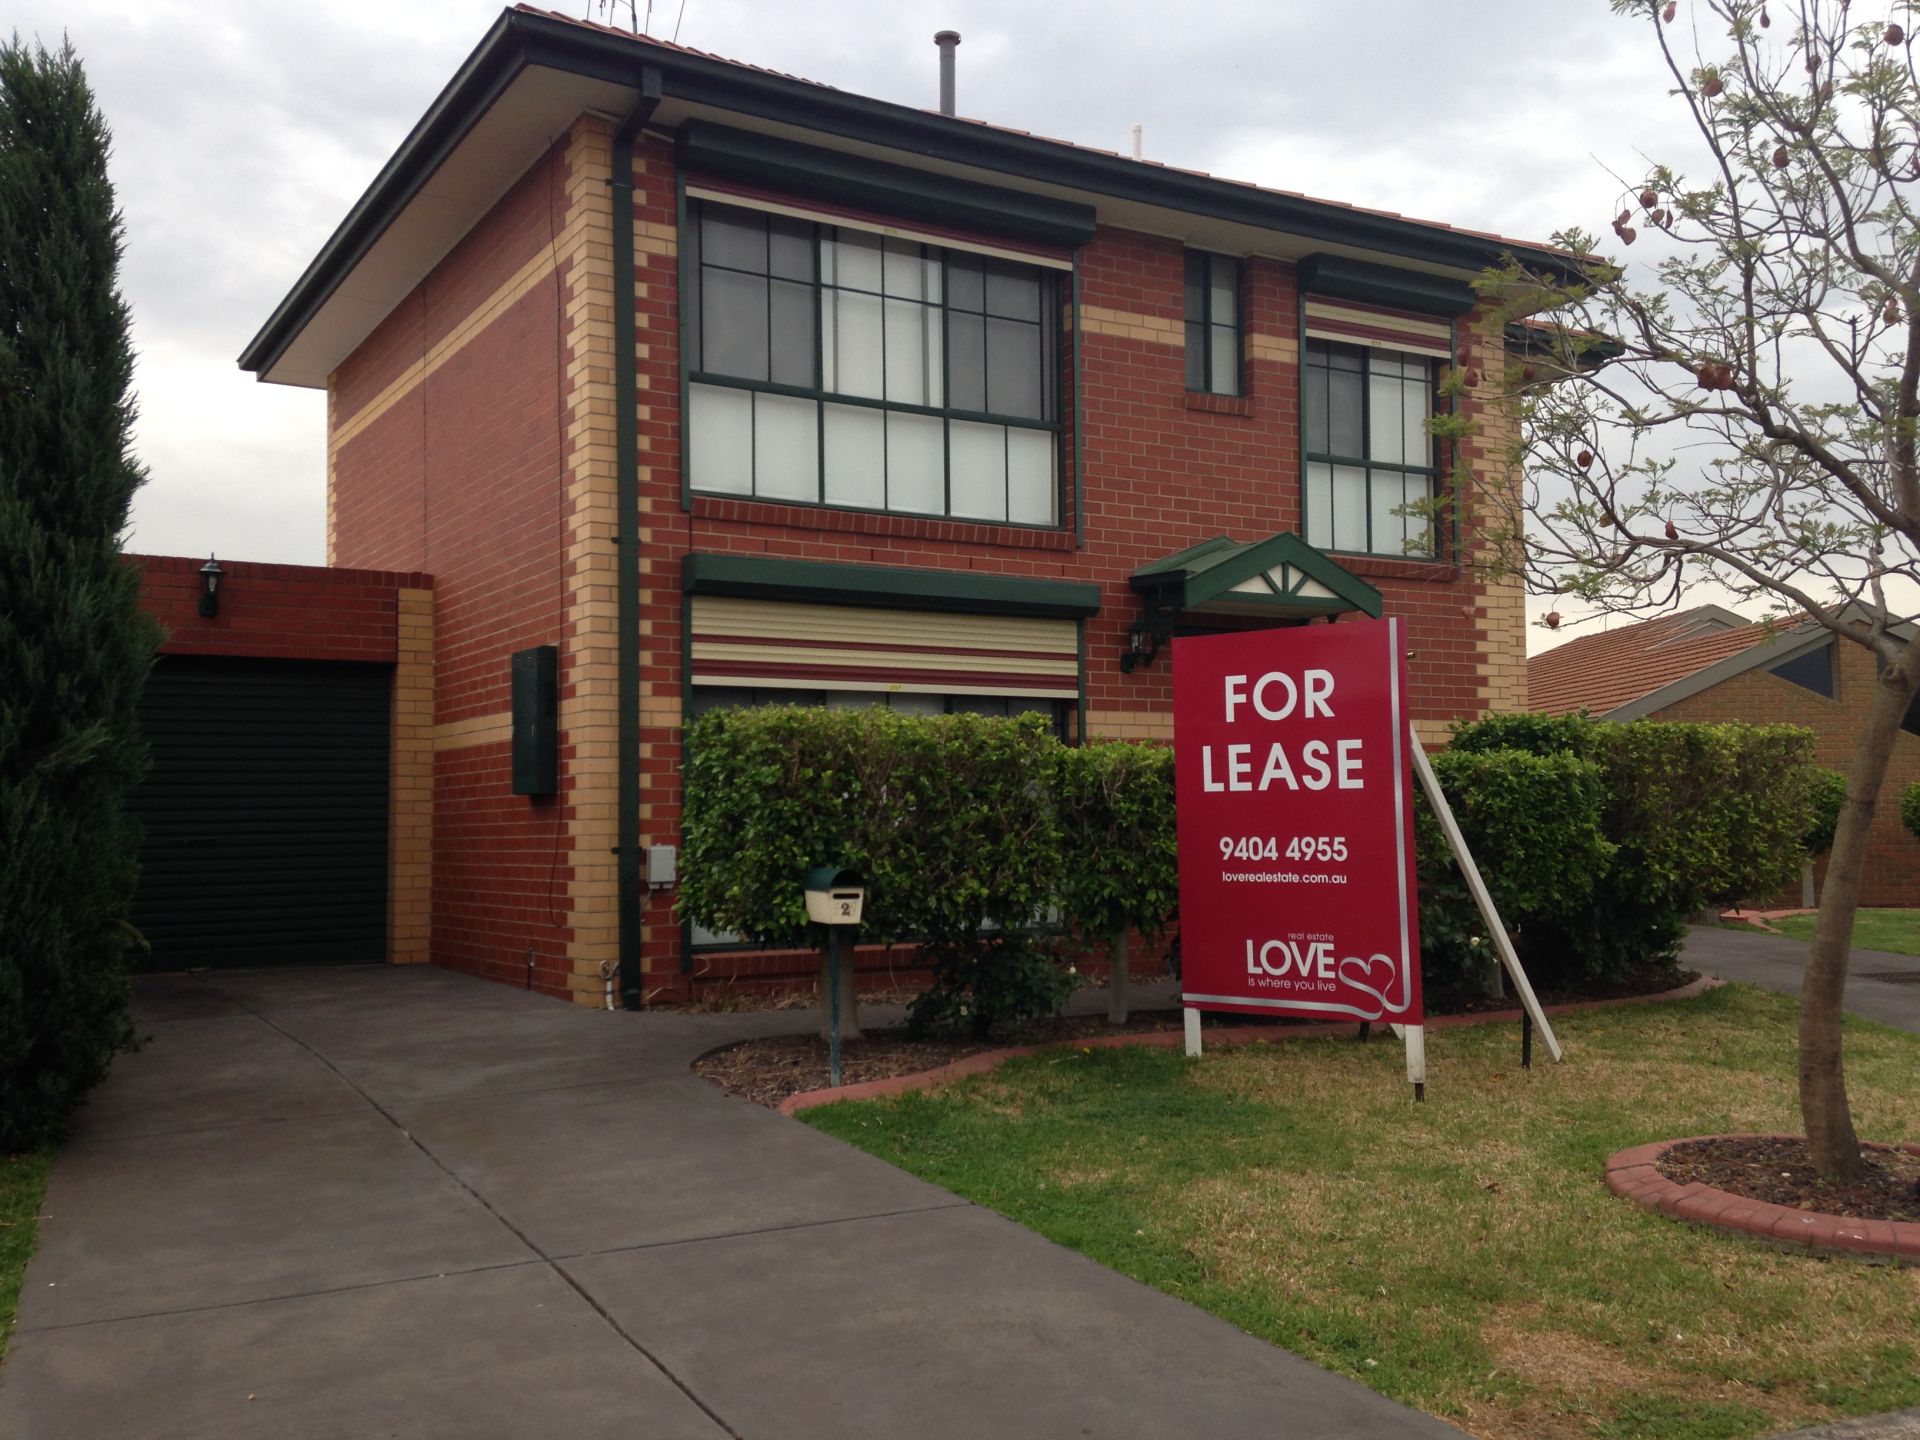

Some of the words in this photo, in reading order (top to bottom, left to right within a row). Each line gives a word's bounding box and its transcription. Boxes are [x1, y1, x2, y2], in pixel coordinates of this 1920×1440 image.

[1225, 669, 1335, 723] FOR
[1202, 739, 1364, 792] LEASE
[1219, 836, 1278, 861] 9404
[1285, 836, 1348, 862] 4955
[1222, 871, 1347, 884] loverealestate.com.au
[841, 902, 850, 917] 2
[1288, 932, 1304, 940] real
[1306, 933, 1334, 942] estate
[1246, 939, 1335, 979] LOVE
[1248, 976, 1255, 987] is
[1258, 977, 1291, 989] where
[1294, 981, 1314, 991] you
[1317, 980, 1336, 992] live
